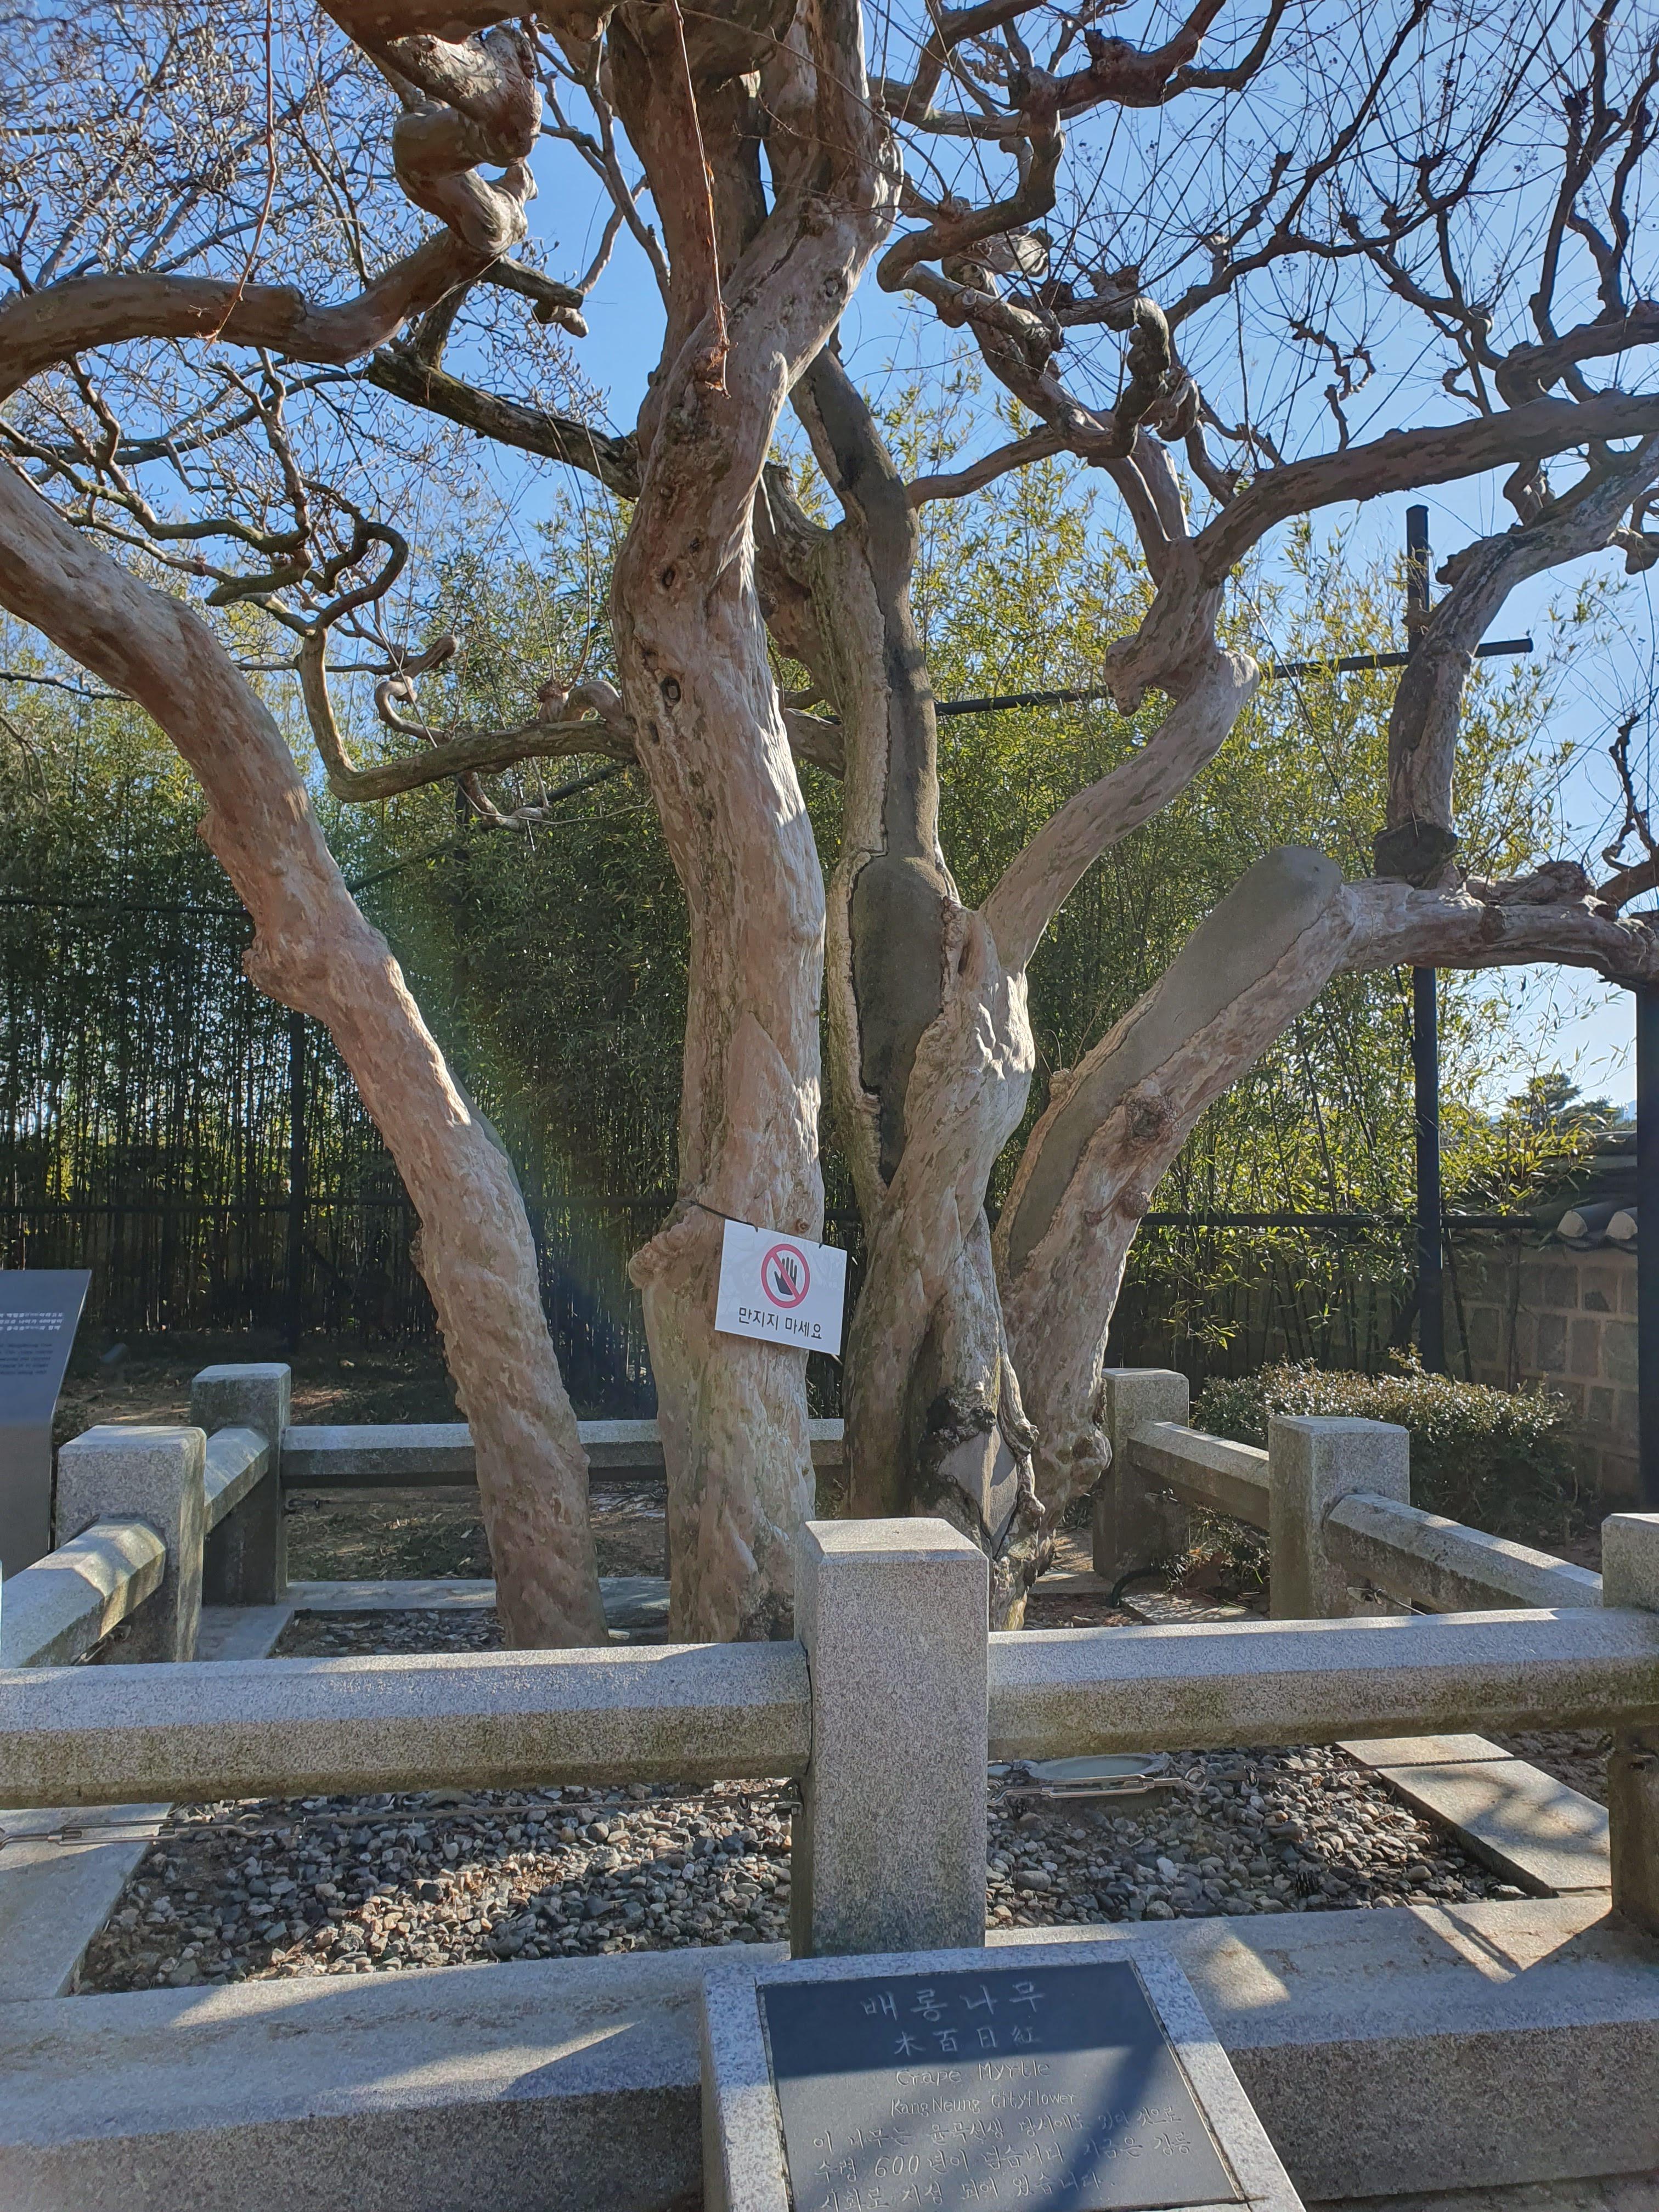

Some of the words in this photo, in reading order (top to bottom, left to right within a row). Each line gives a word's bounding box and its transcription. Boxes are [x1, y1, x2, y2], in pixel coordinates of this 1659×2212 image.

[738, 1307, 779, 1330] 만지지
[785, 1317, 822, 1339] 마세요
[860, 1981, 1045, 2022] 배롱나무
[893, 2025, 1041, 2057] 木百日紅
[895, 2068, 961, 2086] Crape
[977, 2059, 1050, 2081] Myrtle
[813, 2129, 833, 2154] 이
[1153, 2131, 1192, 2157] 강릉
